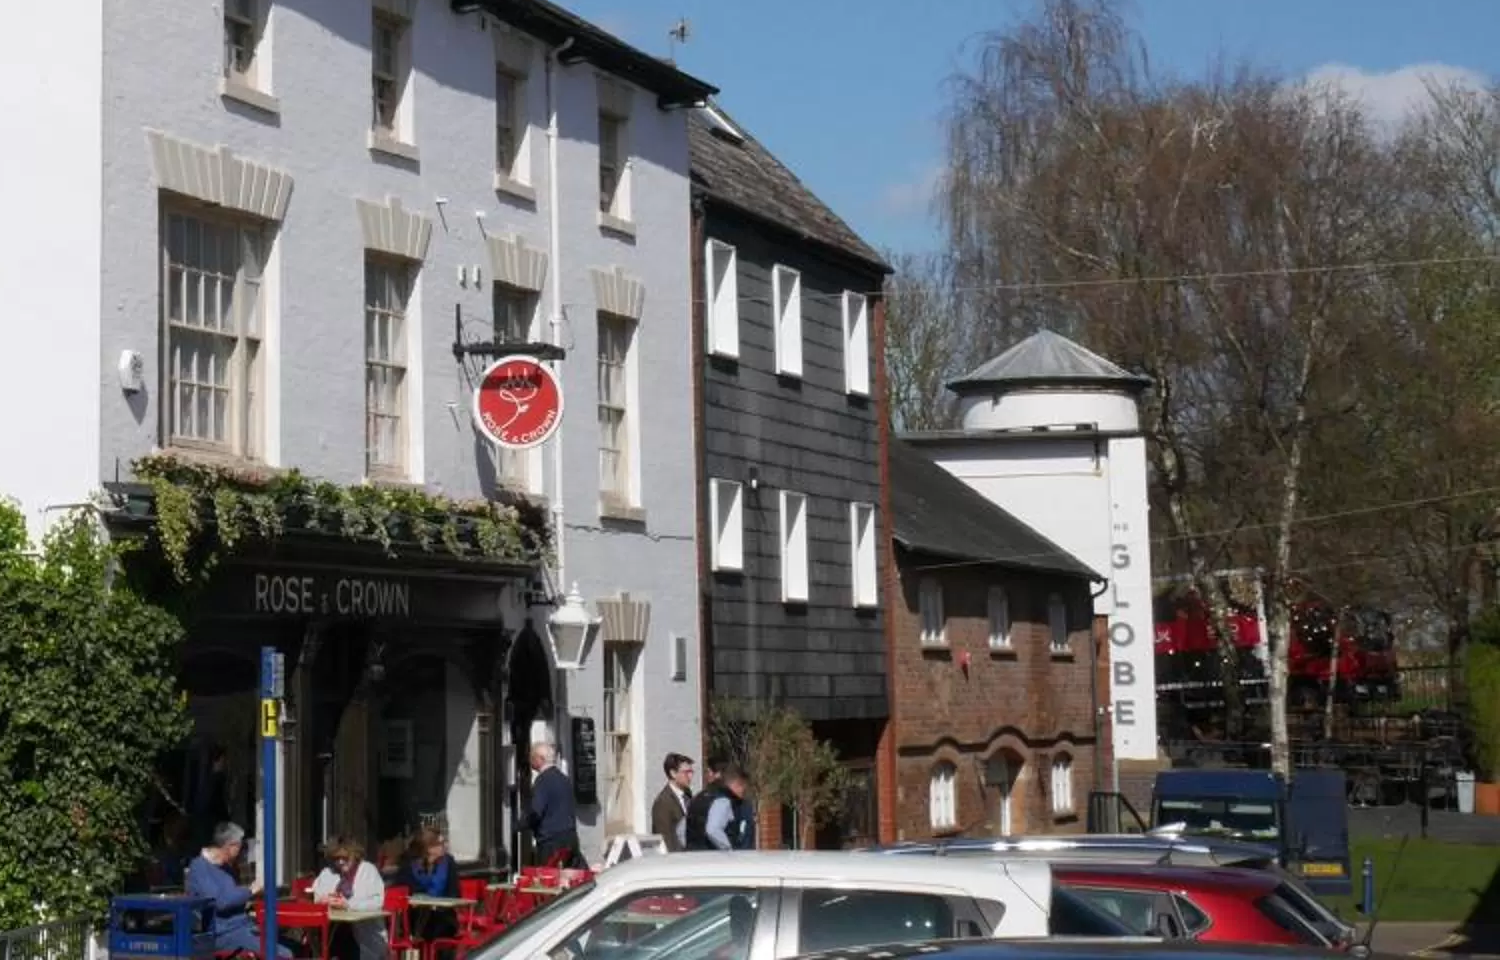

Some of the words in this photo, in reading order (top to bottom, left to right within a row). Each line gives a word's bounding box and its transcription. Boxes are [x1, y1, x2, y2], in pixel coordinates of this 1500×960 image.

[255, 574, 314, 614] ROSE
[336, 578, 409, 617] CROWN
[1110, 544, 1136, 725] GLOBE
